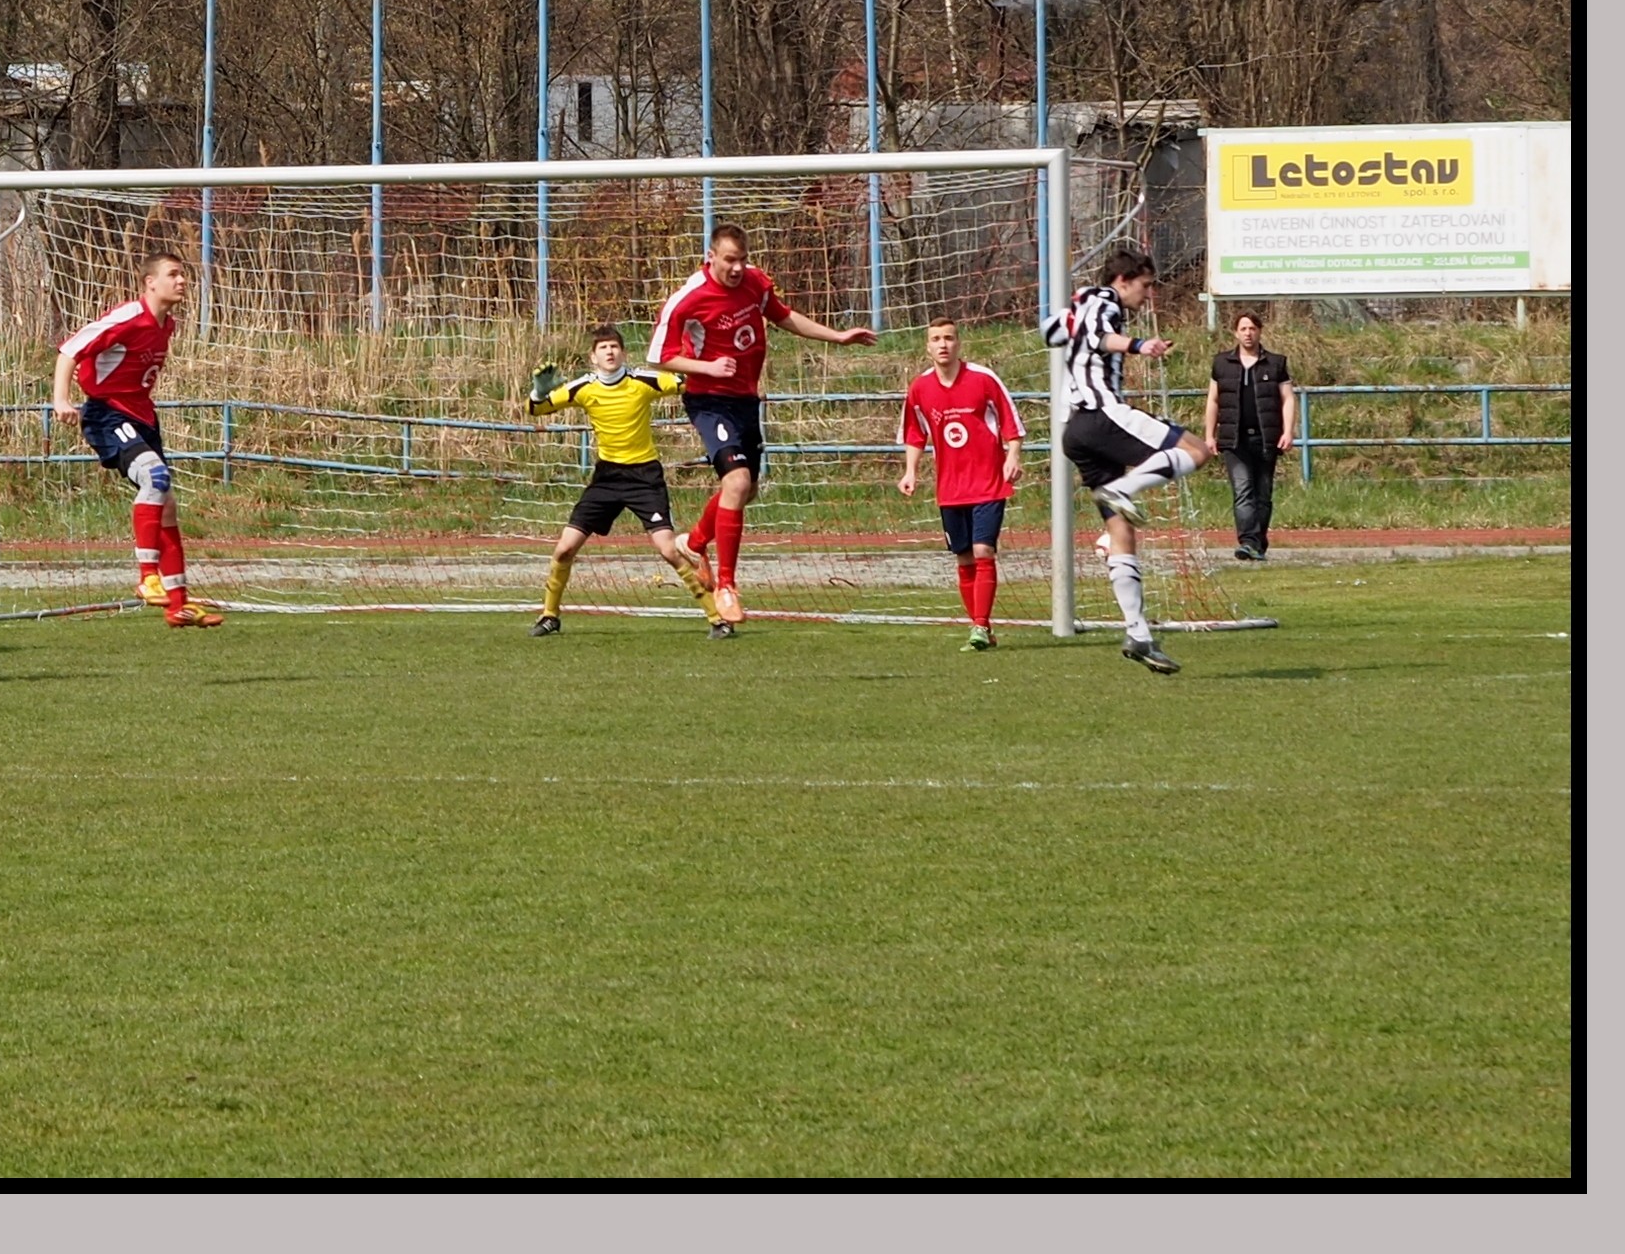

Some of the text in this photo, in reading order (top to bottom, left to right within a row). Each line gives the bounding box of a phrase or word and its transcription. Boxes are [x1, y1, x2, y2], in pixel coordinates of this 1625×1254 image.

[1251, 152, 1459, 187] Letostav
[1403, 187, 1430, 197] spol.
[1319, 212, 1387, 230] ČINNOST
[1242, 233, 1353, 249] REGENERACE
[1327, 258, 1363, 268] DOTACE
[1365, 258, 1373, 267] A
[1374, 257, 1424, 267] REALIZACE
[114, 422, 137, 443] 10
